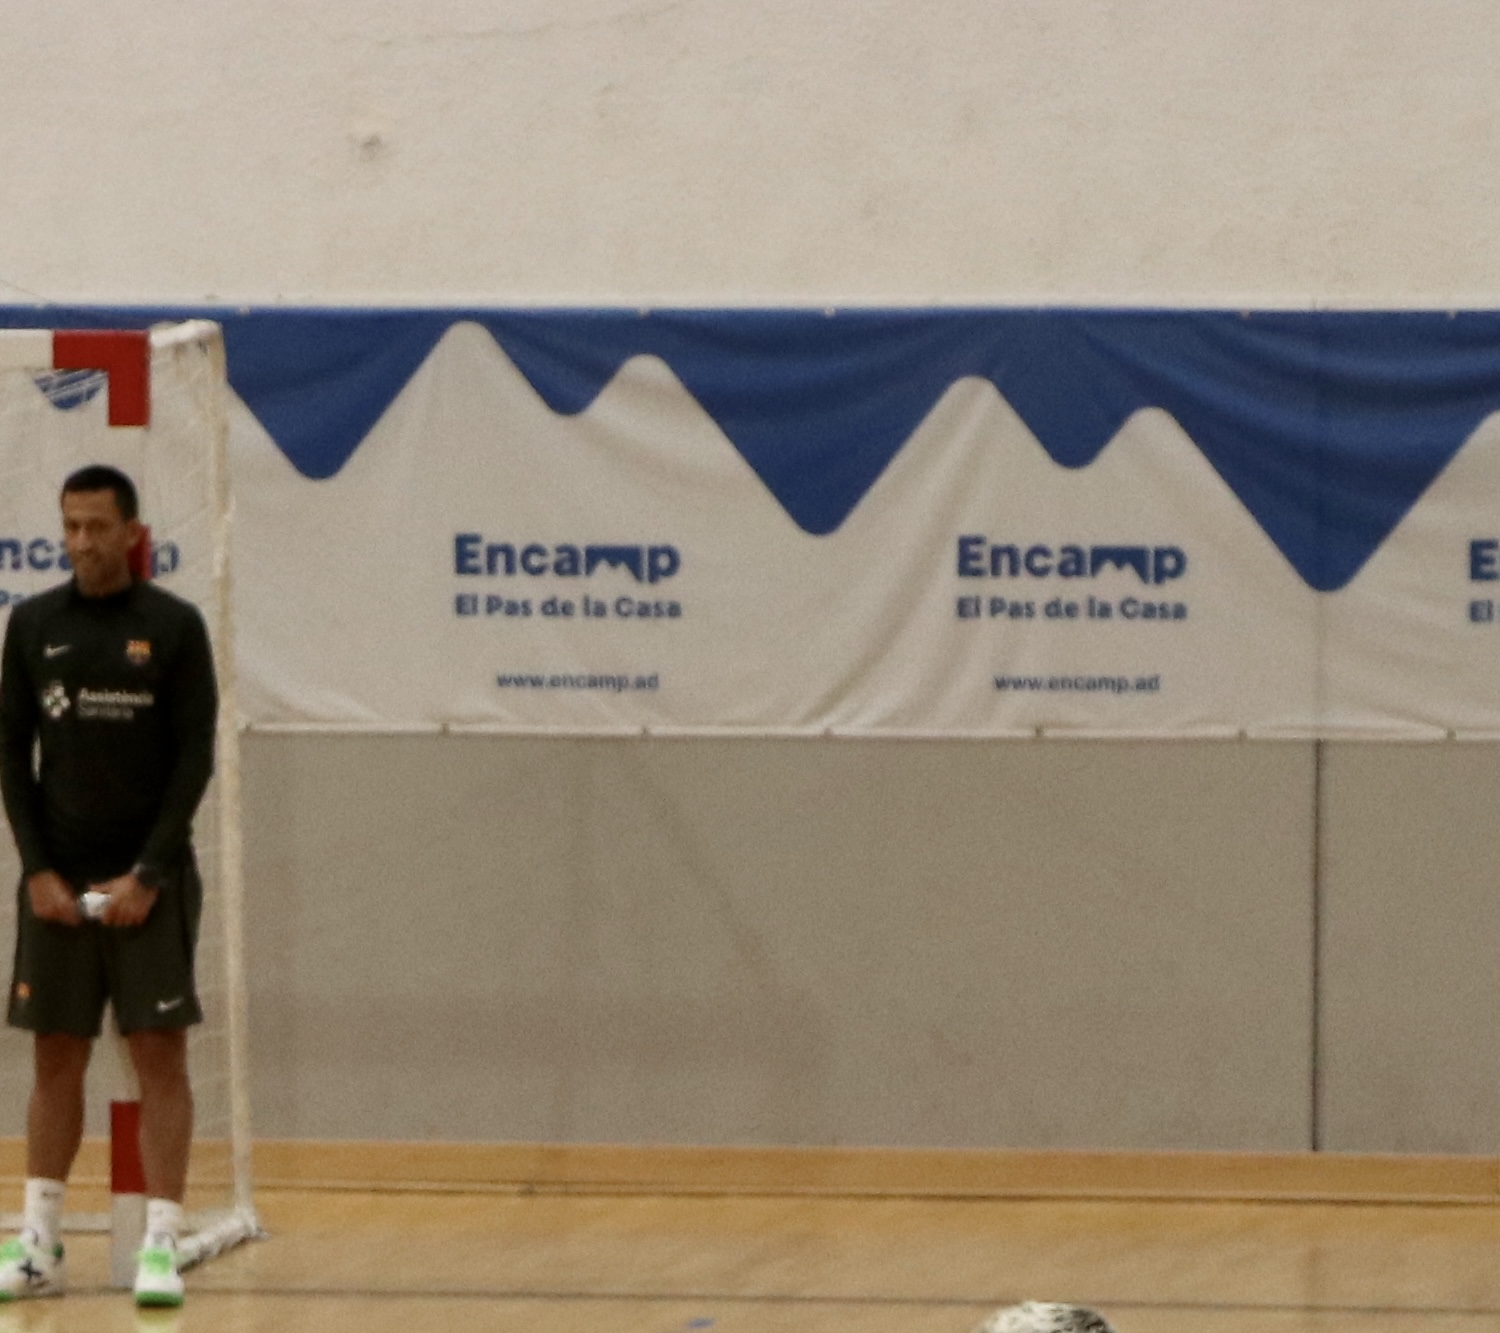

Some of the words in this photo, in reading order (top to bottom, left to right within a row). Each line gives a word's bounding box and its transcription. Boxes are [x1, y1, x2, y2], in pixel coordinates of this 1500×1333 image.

[454, 533, 681, 584] Encamp
[957, 535, 1187, 585] Encamp
[455, 594, 478, 616] El
[485, 595, 532, 617] Pas
[540, 597, 575, 617] de
[582, 596, 608, 618] la
[614, 596, 682, 619] Casa
[956, 597, 981, 619] El
[988, 597, 1036, 619] Pas
[1043, 599, 1079, 619] de
[1087, 597, 1113, 619] la
[1118, 597, 1188, 620] Casa
[1469, 601, 1493, 623] El
[496, 674, 660, 693] www.encamp.ad
[993, 675, 1161, 694] www.encamp.ad
